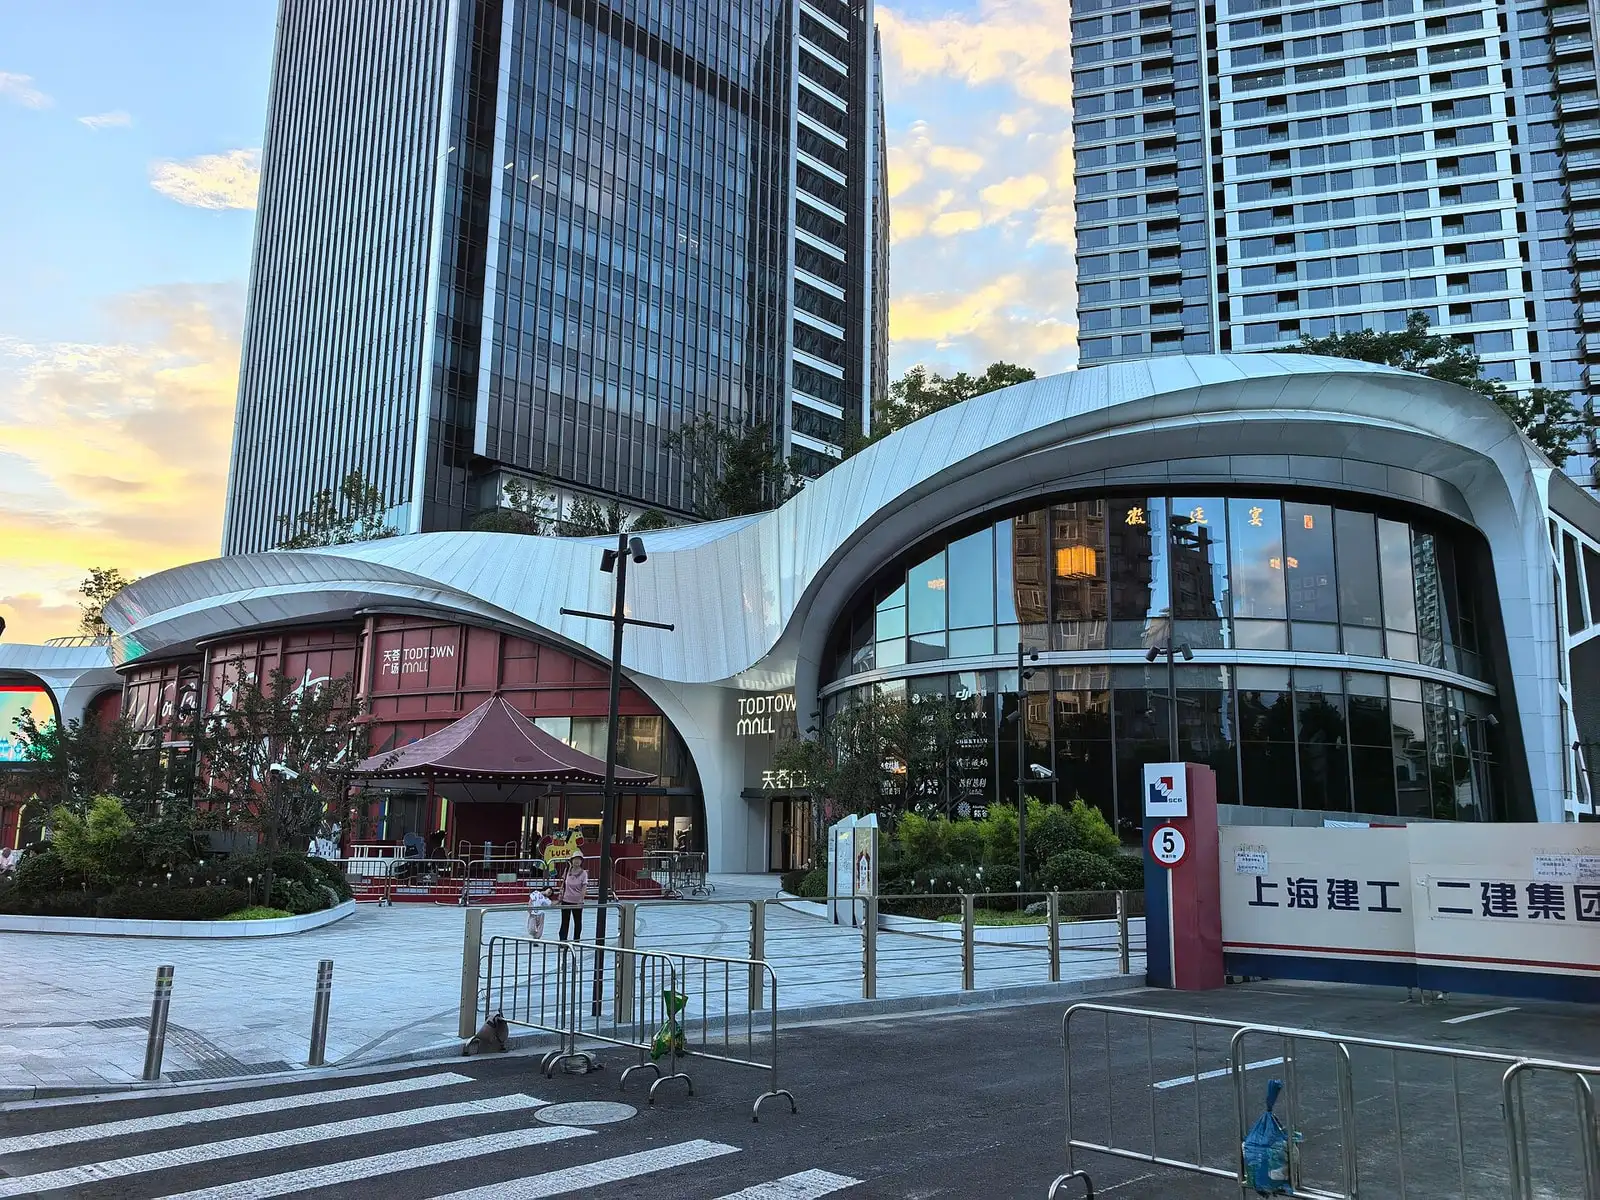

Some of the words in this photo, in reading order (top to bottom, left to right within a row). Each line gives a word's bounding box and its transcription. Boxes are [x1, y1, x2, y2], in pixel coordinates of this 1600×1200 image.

[403, 645, 454, 660] TODTOWN
[382, 662, 400, 675] 广场
[401, 661, 428, 674] MALL
[736, 717, 776, 736] MALL
[1162, 831, 1175, 854] 5
[551, 849, 571, 857] LUCK
[1248, 875, 1402, 913] 上海建工
[1436, 880, 1600, 922] 二建集团
